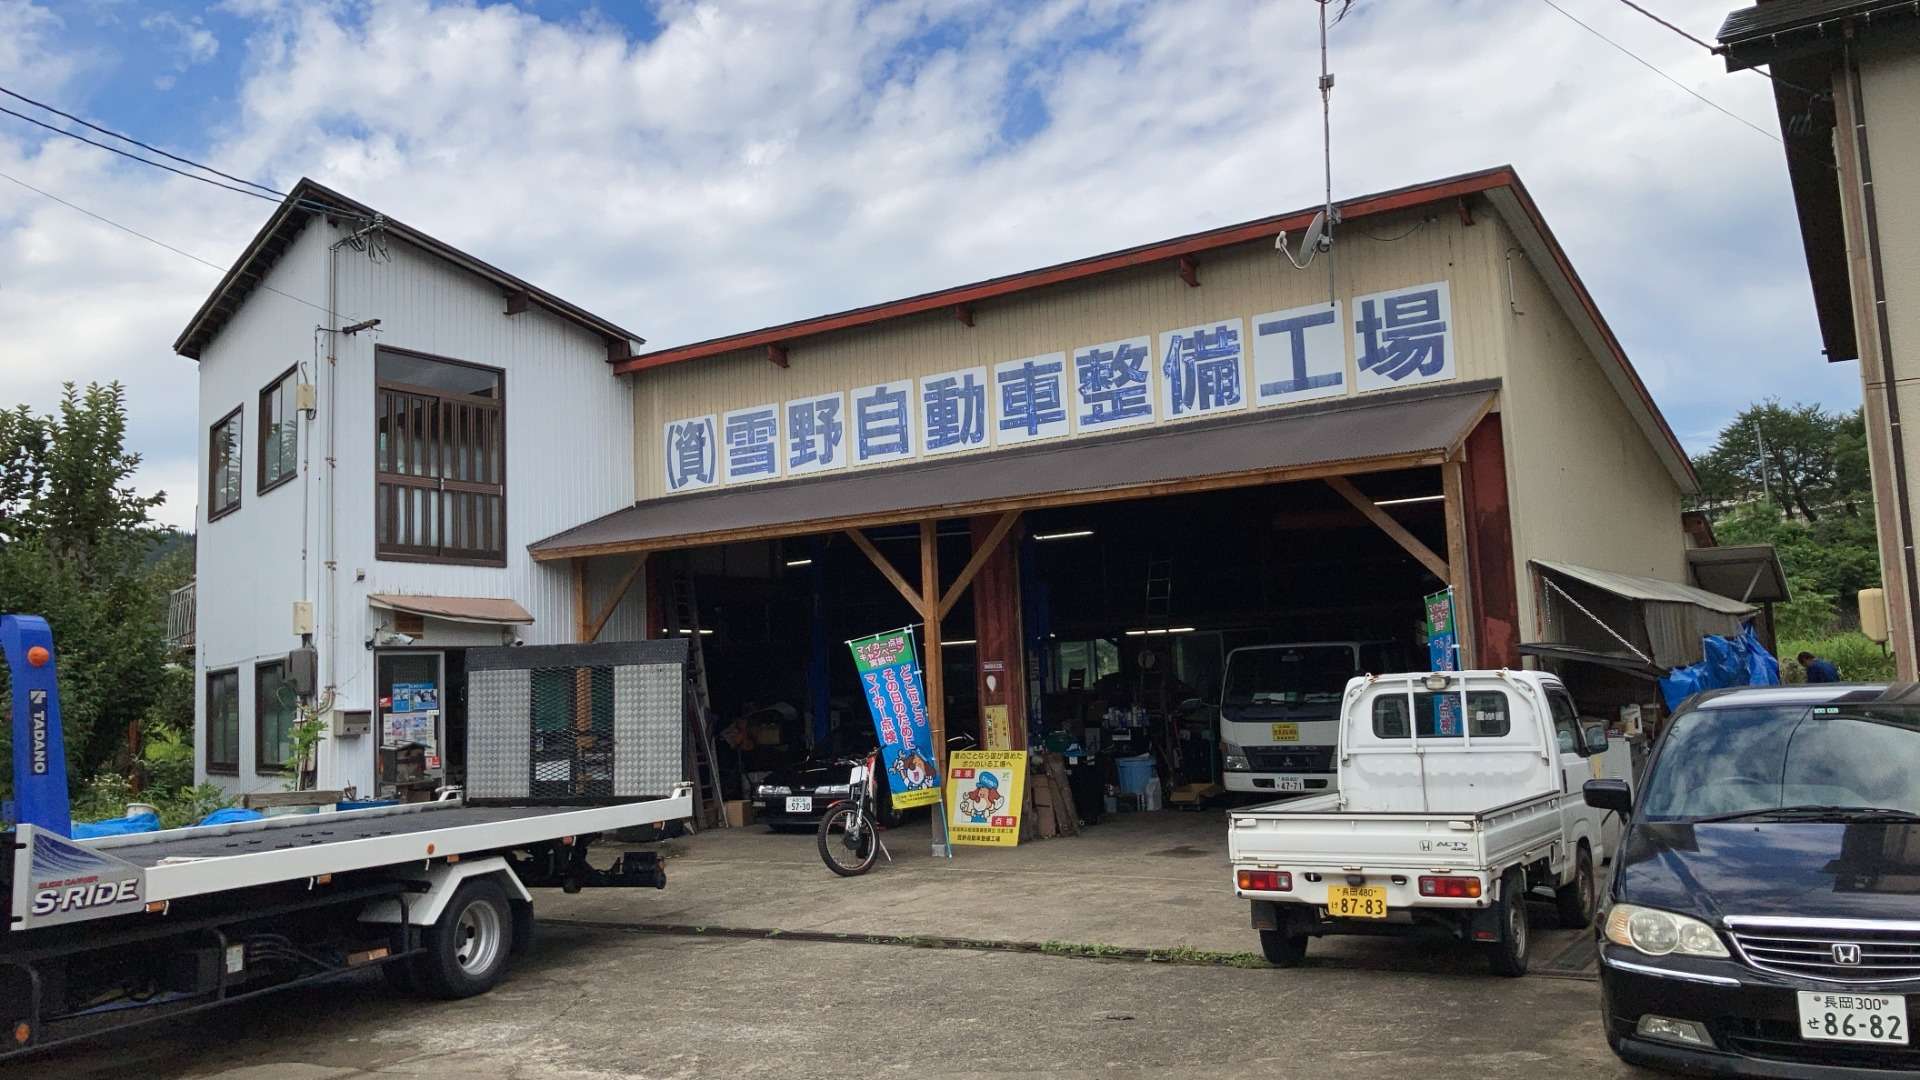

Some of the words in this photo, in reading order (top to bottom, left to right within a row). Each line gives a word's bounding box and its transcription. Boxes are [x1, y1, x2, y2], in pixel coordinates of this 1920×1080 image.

[864, 673, 898, 744] マイカー点検
[882, 668, 915, 750] その日のために
[33, 710, 45, 774] TADANO
[31, 877, 140, 915] S-RIDE
[1807, 1017, 1820, 1030] せ
